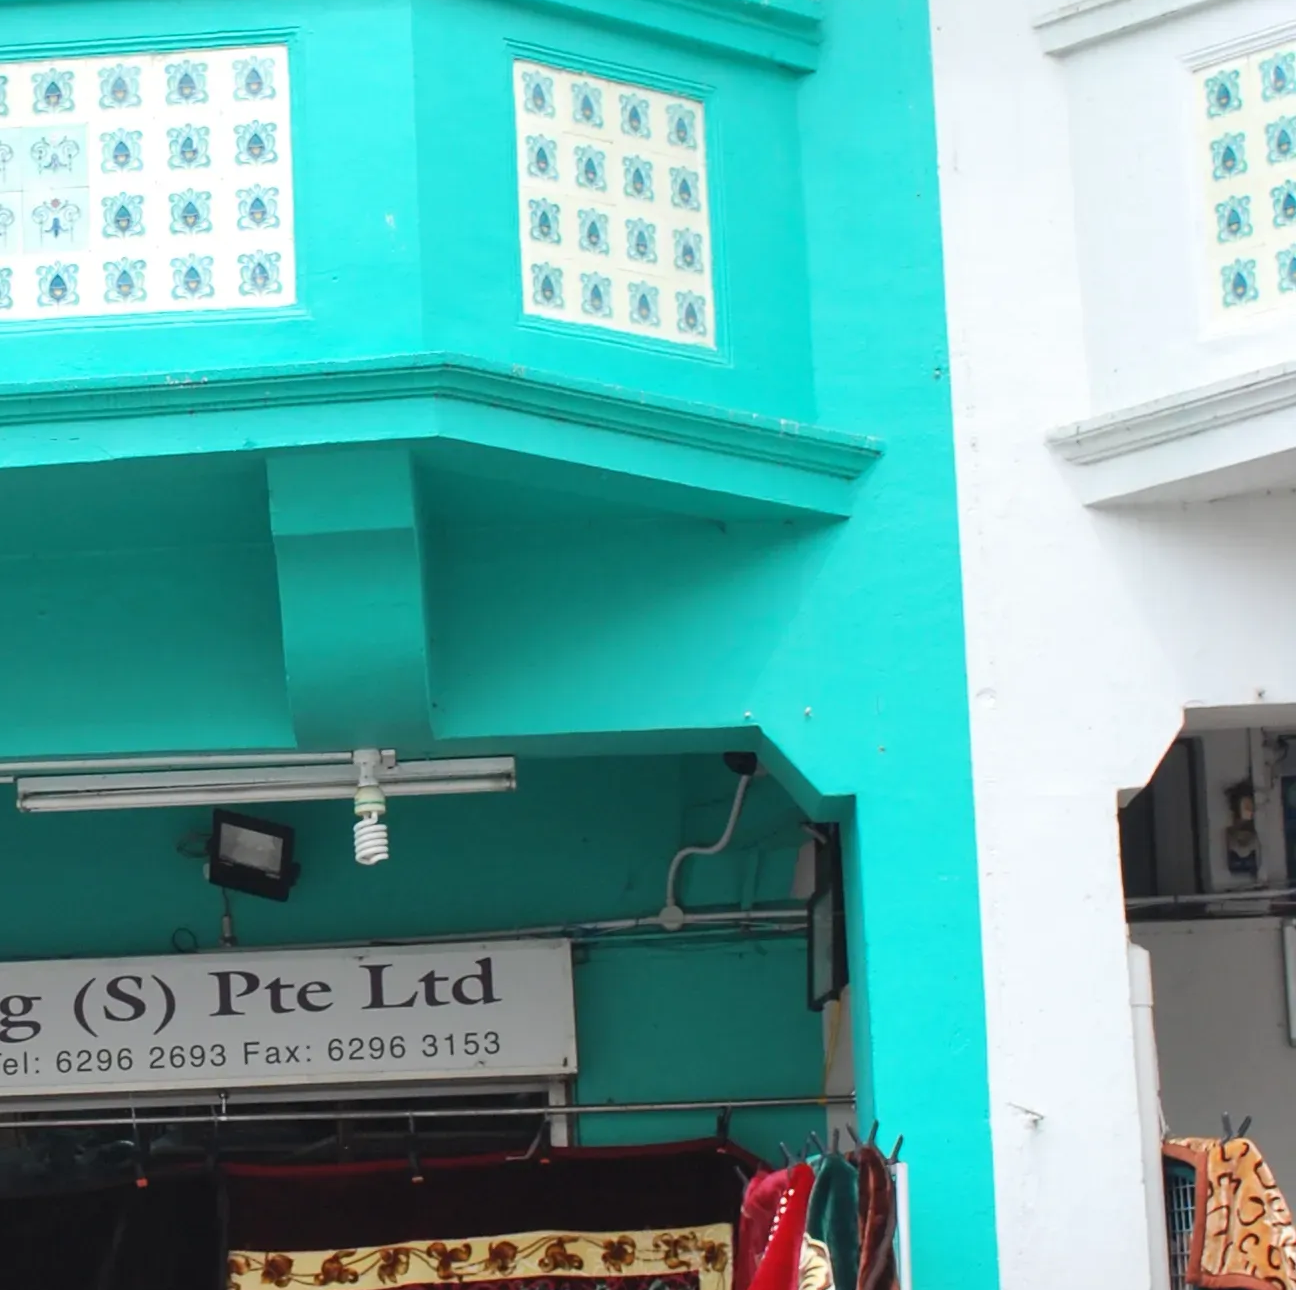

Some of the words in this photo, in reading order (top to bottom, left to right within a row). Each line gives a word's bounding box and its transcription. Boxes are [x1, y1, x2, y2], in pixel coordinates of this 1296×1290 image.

[73, 974, 177, 1038] (S)
[208, 970, 334, 1017] Pte
[359, 956, 503, 1010] Ltd
[55, 1047, 134, 1074] 6296
[149, 1043, 227, 1070] 2693
[243, 1040, 313, 1066] Fax:
[327, 1035, 406, 1062] 6296
[421, 1030, 501, 1058] 3153
